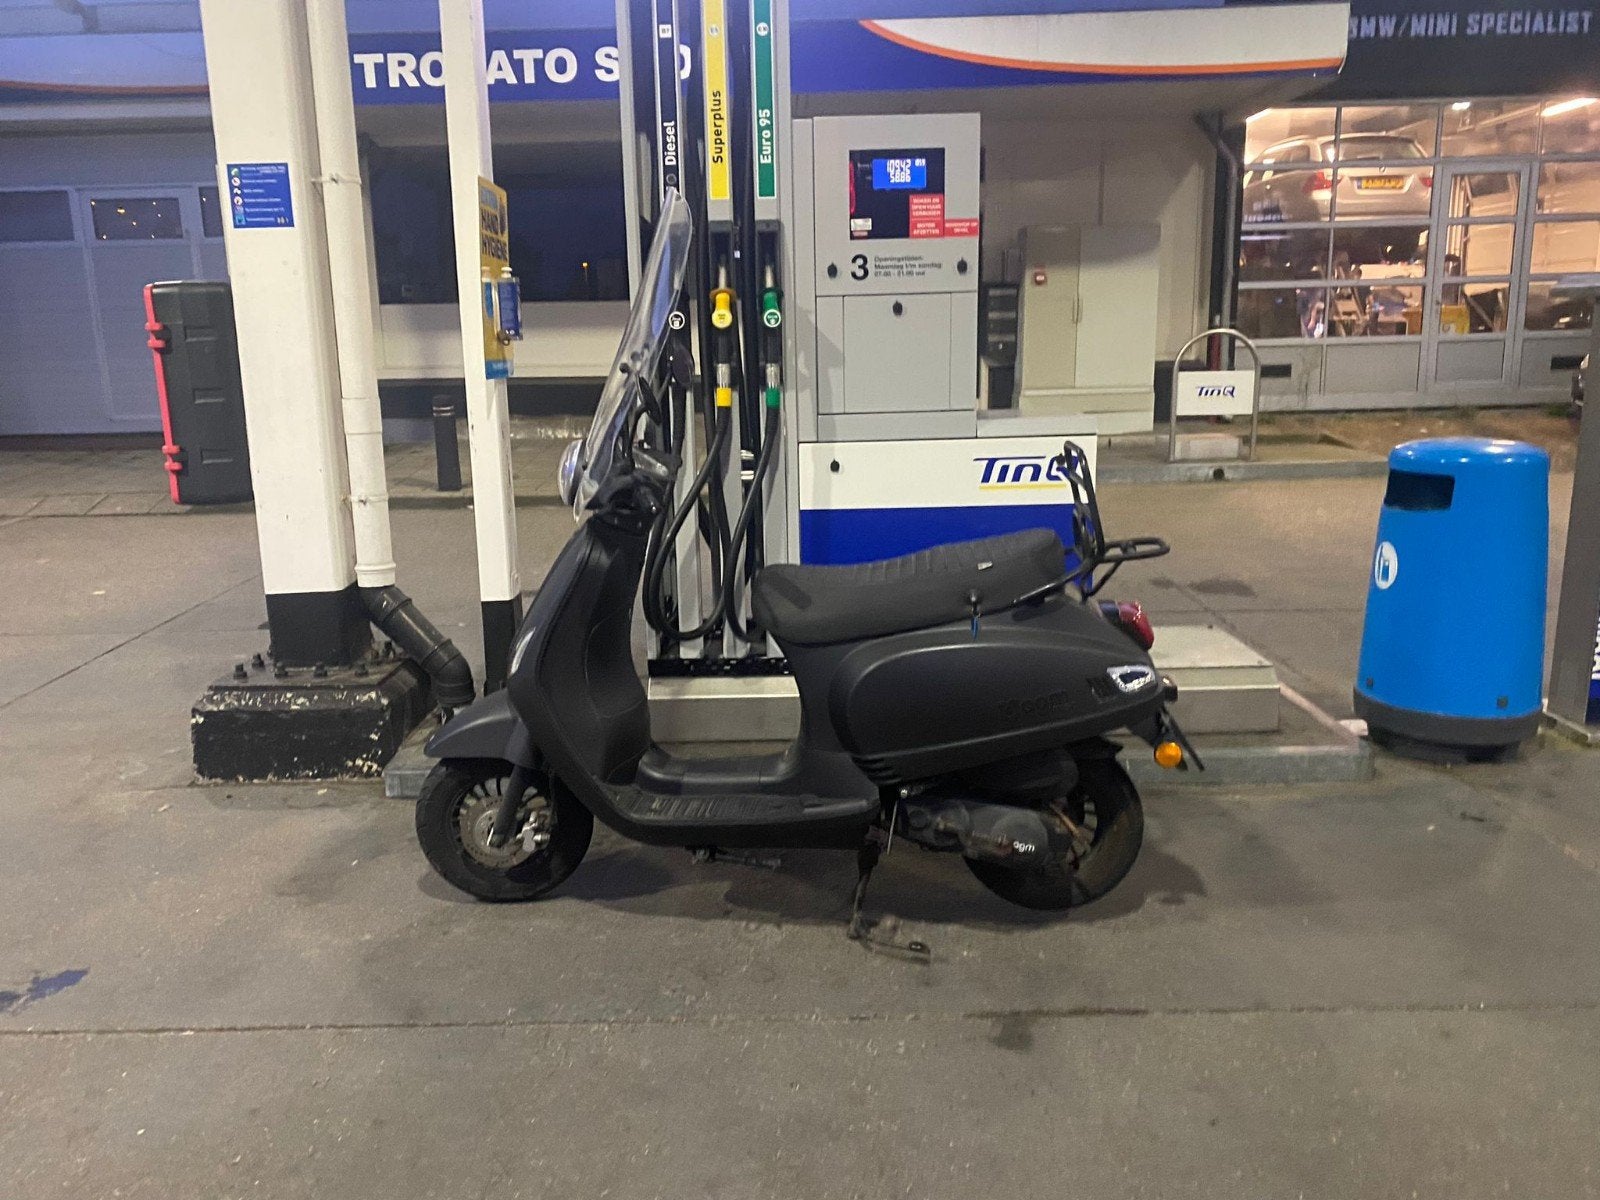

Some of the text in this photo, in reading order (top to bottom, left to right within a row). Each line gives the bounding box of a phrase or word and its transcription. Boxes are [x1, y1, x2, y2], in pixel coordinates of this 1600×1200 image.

[1467, 11, 1593, 35] SPECIALIST
[353, 47, 577, 88] TROATO
[663, 120, 676, 165] Diesel
[711, 90, 725, 163] Superplus
[758, 108, 771, 164] Euro 95
[851, 254, 869, 280] 3
[1013, 841, 1035, 853] agm
